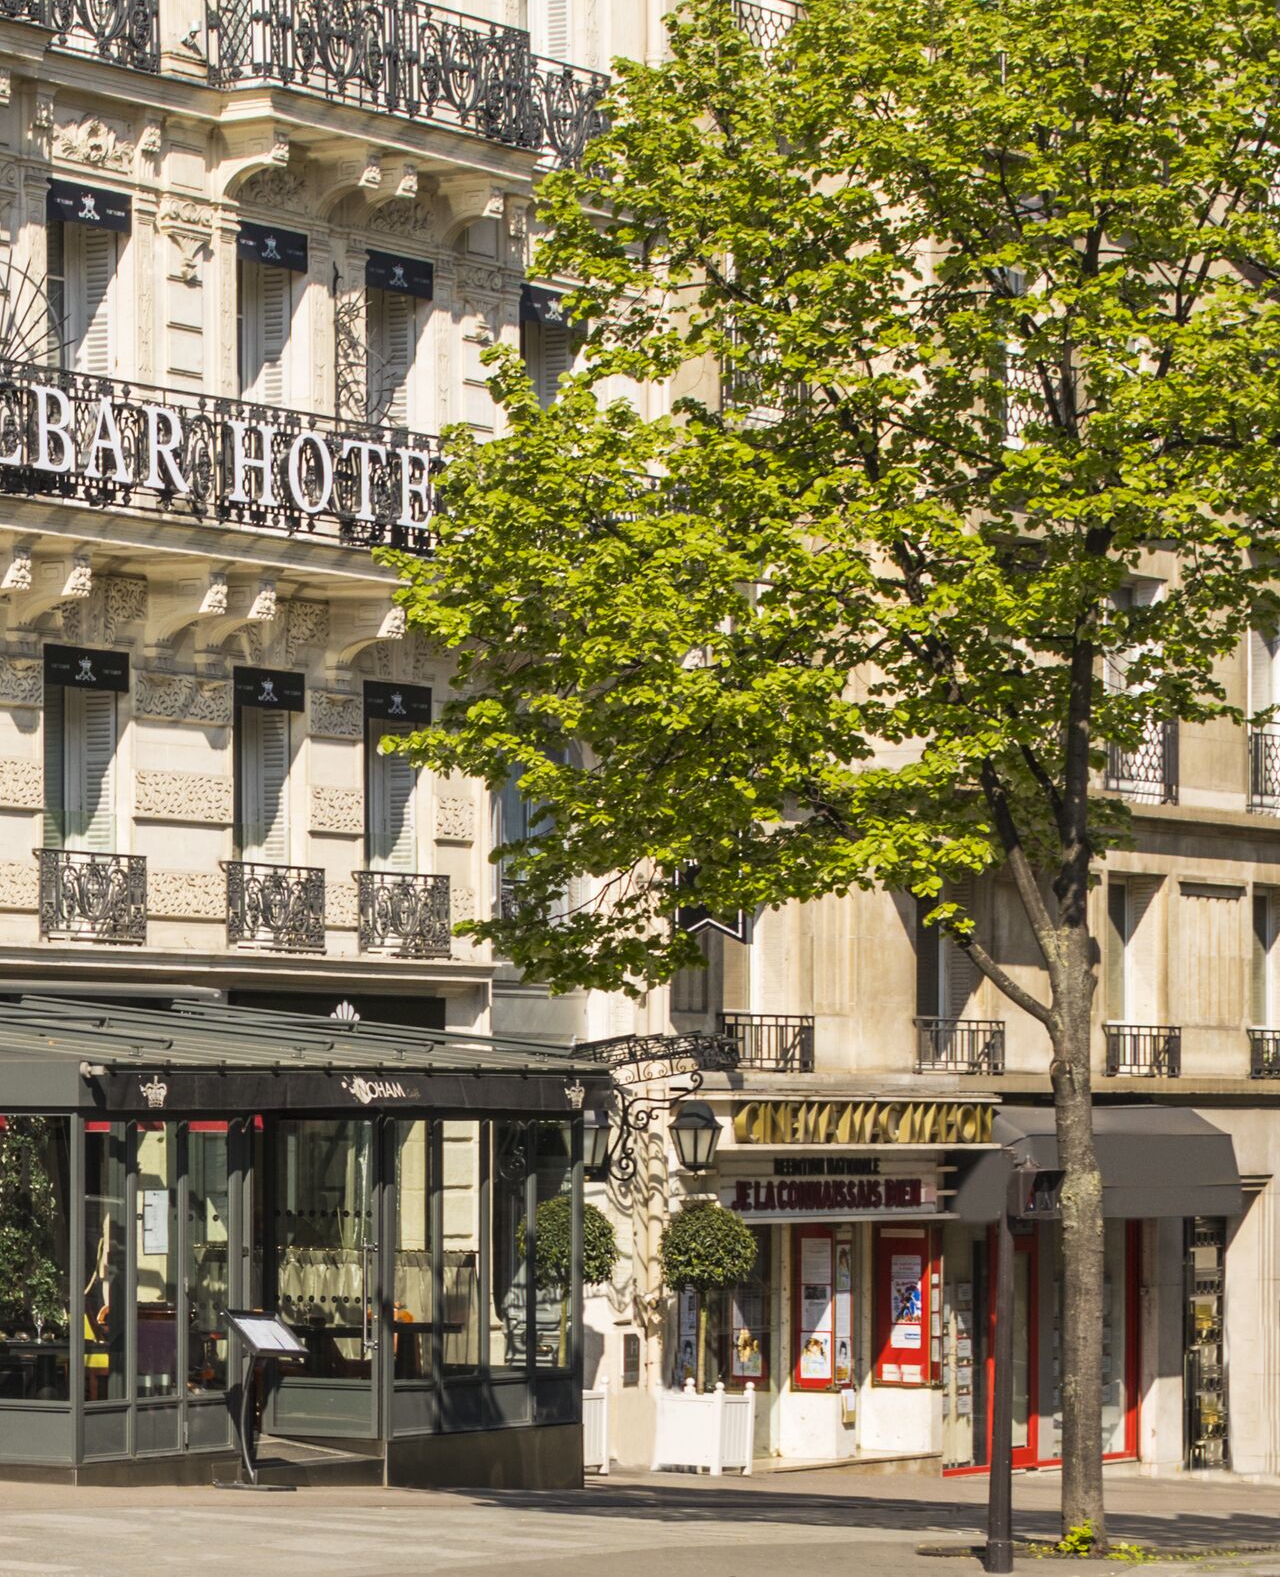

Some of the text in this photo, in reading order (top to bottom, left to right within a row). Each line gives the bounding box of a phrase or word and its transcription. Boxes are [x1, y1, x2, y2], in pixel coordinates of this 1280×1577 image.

[227, 422, 433, 530] HOTE
[731, 1180, 753, 1211] JE
[753, 1180, 777, 1211] LA
[777, 1179, 883, 1211] CONNAISSAIS
